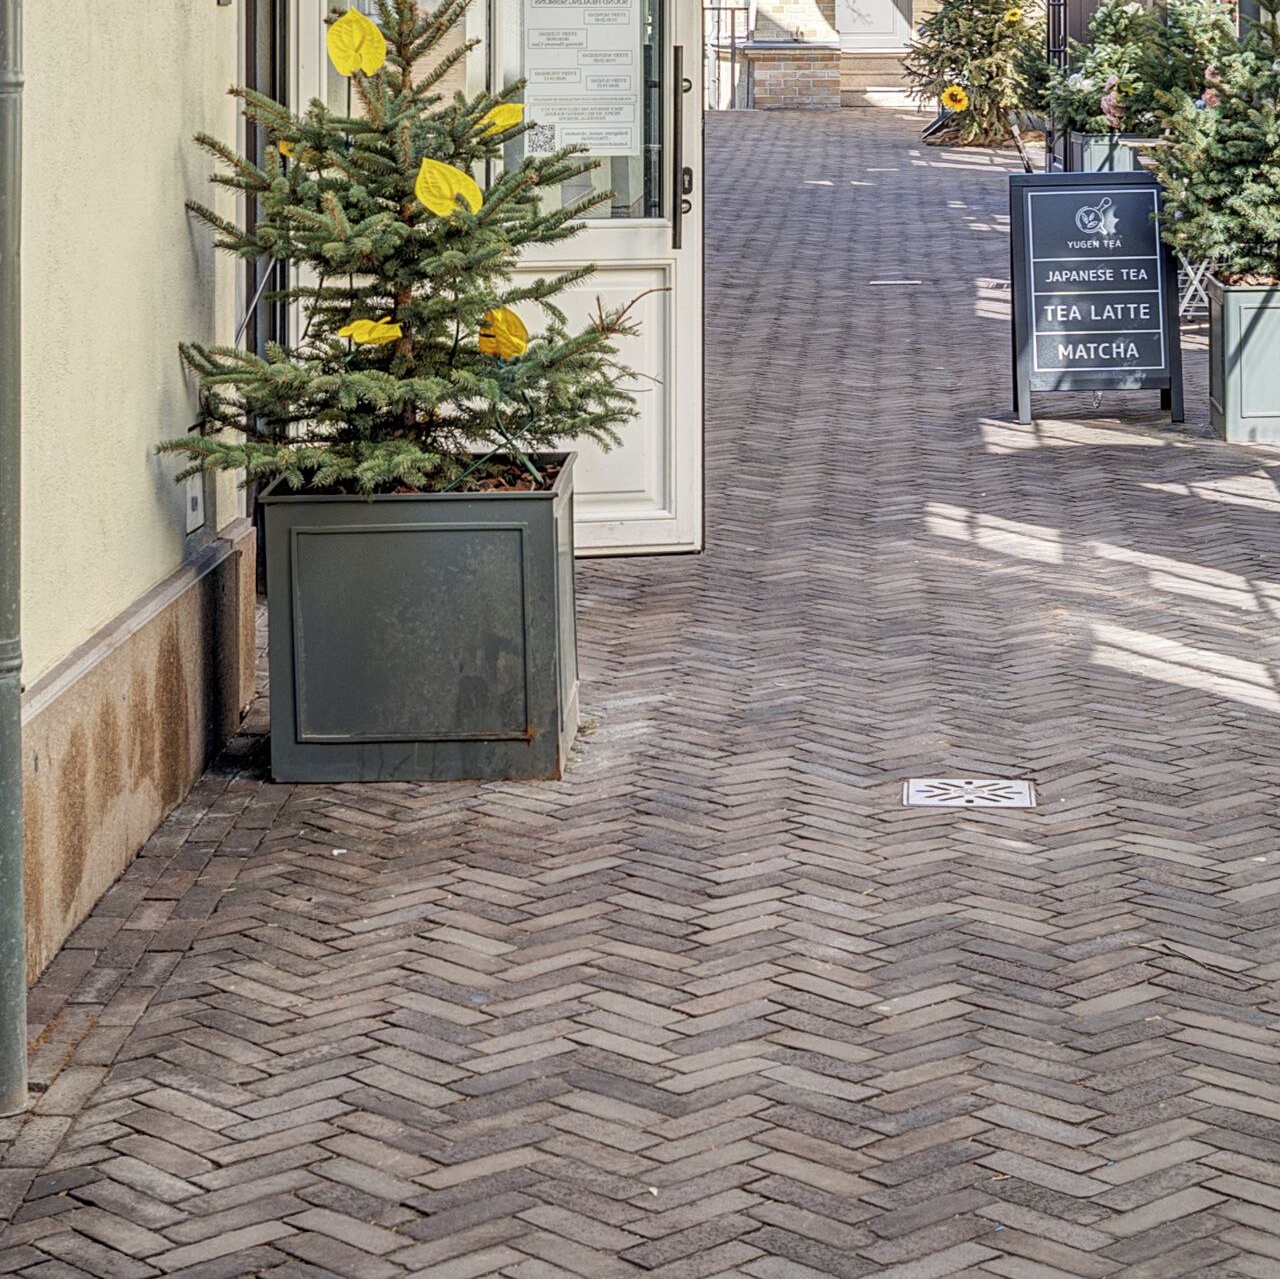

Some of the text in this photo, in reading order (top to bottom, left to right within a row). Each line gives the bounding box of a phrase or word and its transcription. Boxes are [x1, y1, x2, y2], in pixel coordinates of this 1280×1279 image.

[1067, 240, 1122, 249] YUGEN TEA
[1045, 268, 1148, 283] JAPANESE TEA
[1044, 304, 1151, 321] TEA LATTE
[1058, 342, 1140, 360] MATCHA
